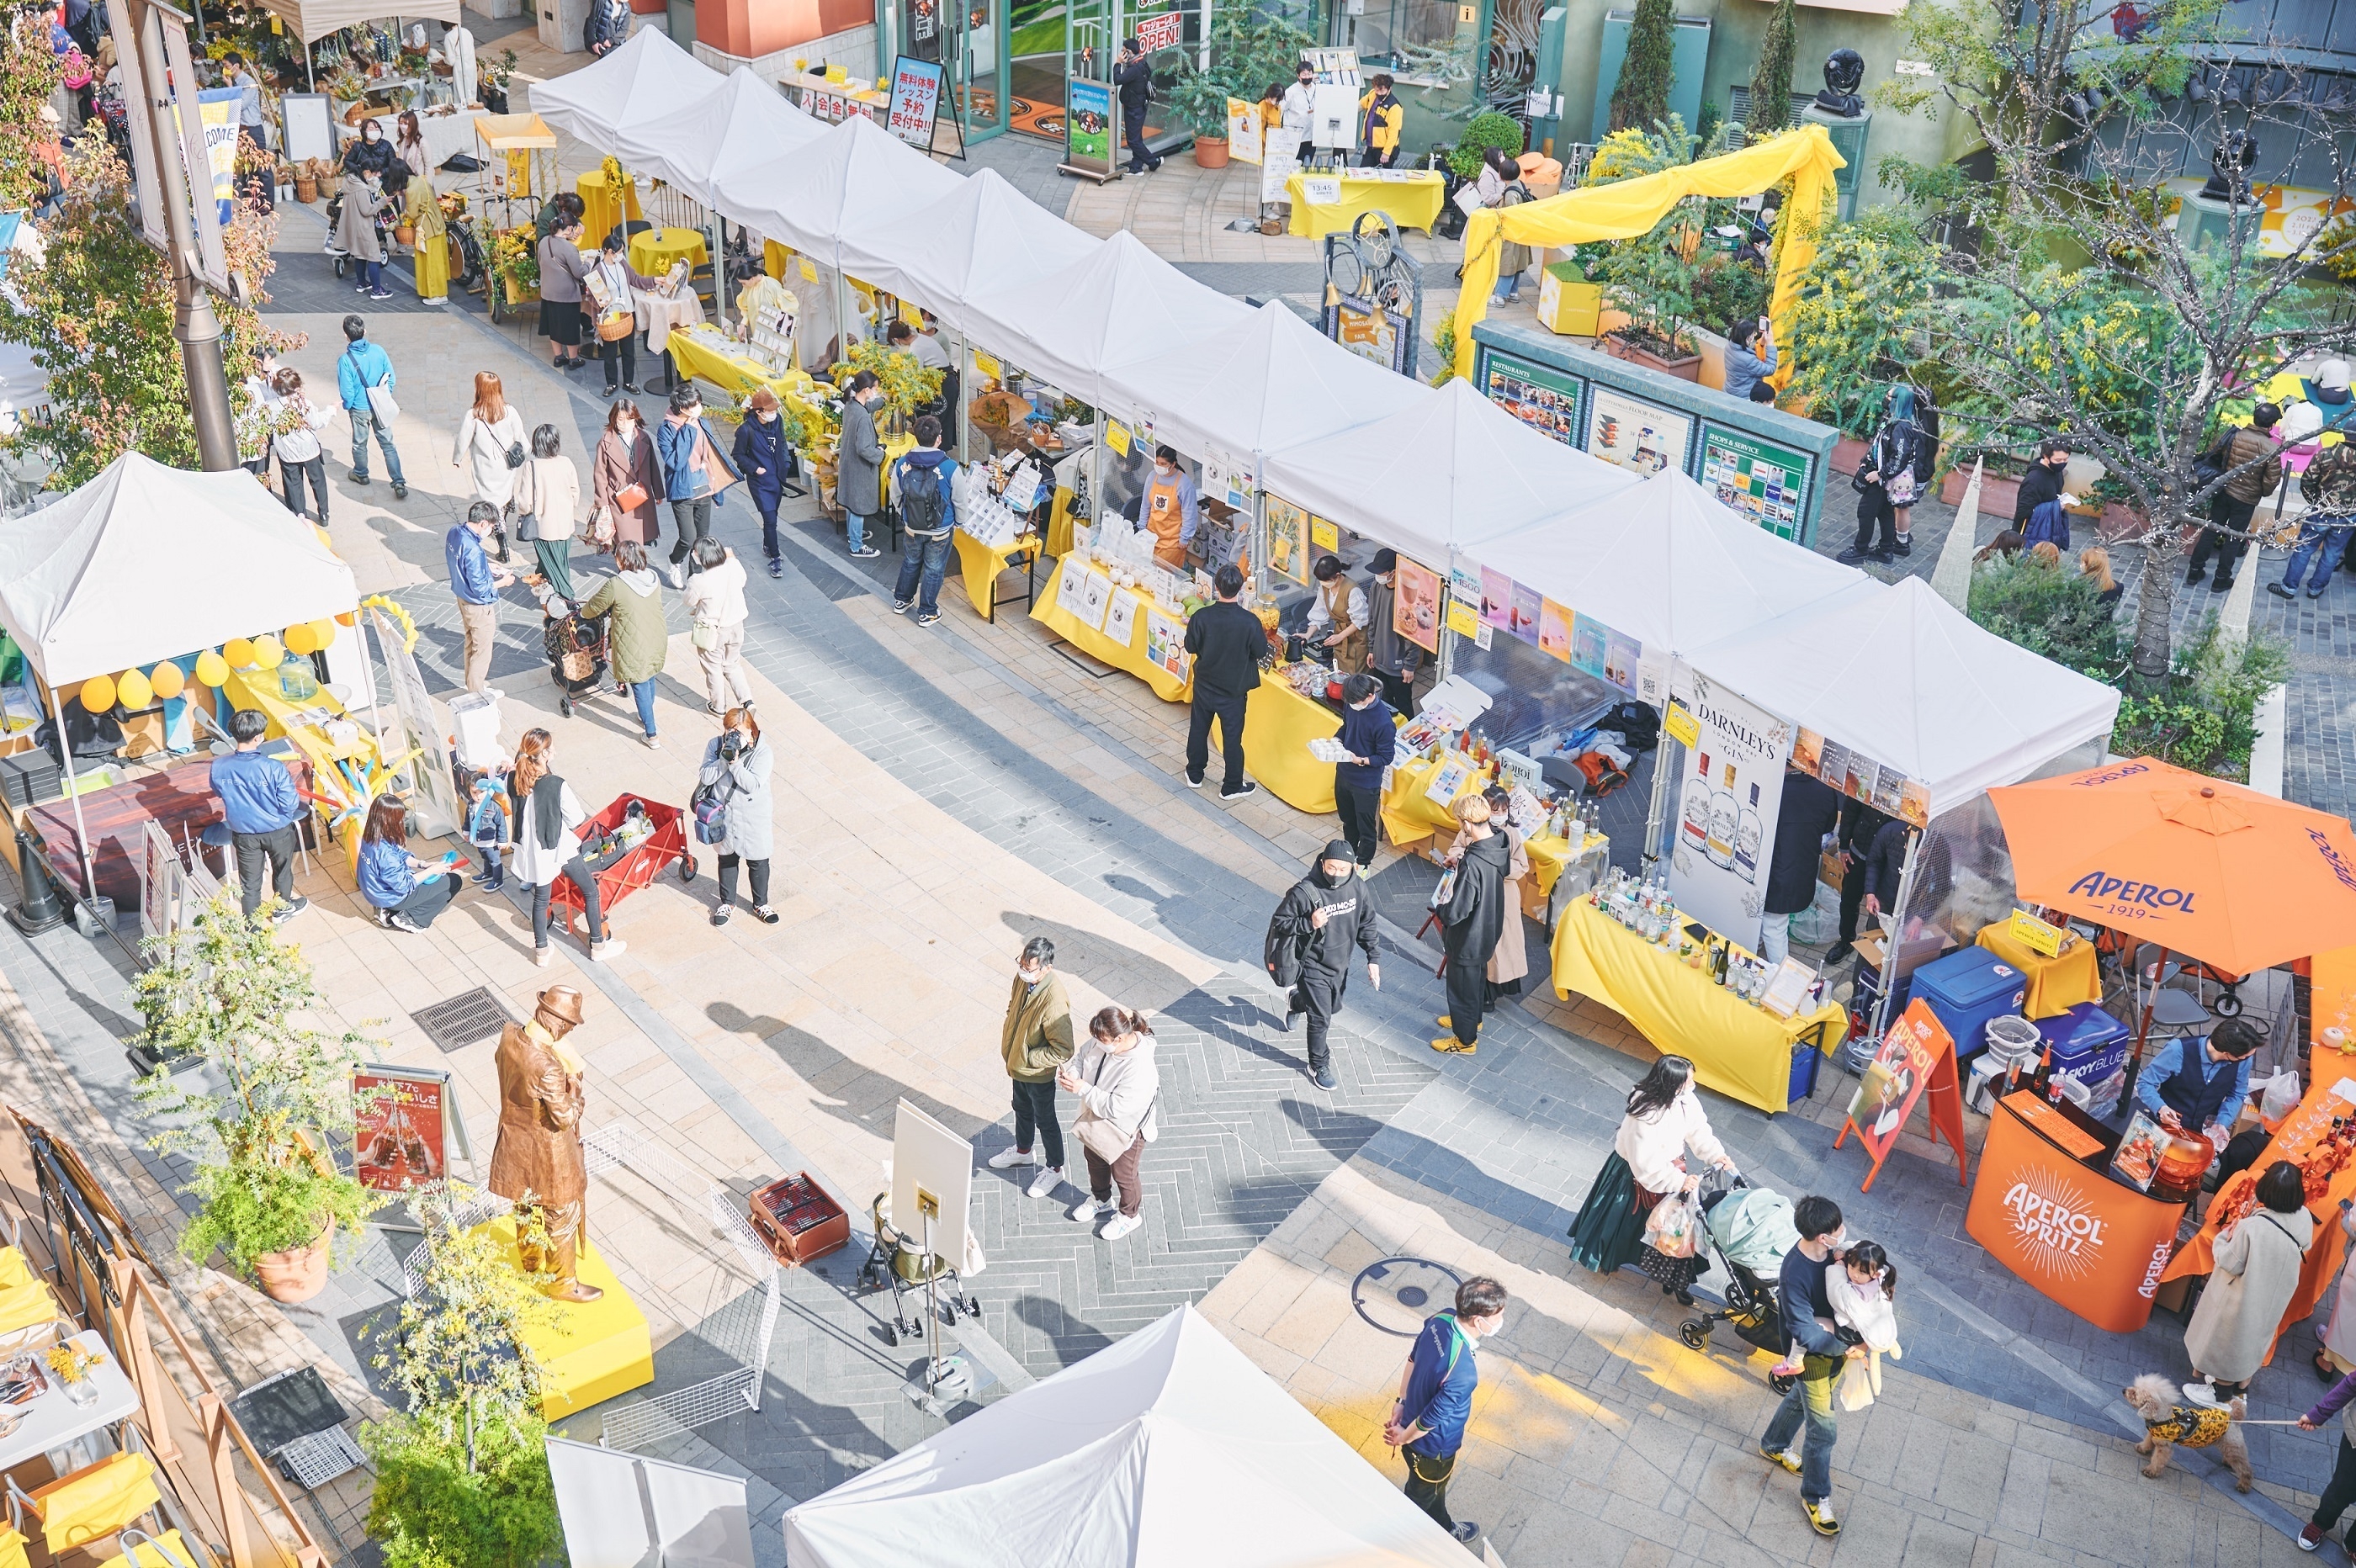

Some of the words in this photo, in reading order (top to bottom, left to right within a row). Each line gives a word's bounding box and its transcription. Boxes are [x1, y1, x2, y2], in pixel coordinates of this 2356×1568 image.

[1142, 15, 1176, 31] マッジョーレB1
[1138, 25, 1180, 55] OPEN!
[899, 72, 937, 91] 無料体験
[898, 85, 934, 101] レッスン
[902, 98, 925, 115] 予約
[890, 112, 931, 134] 受付中!!
[1492, 360, 1530, 379] RESTAURANTS
[1628, 405, 1649, 416] FLOOR
[1649, 412, 1664, 421] MAP
[1708, 432, 1729, 446] SHOPS
[1734, 442, 1760, 455] SERVICE
[1698, 703, 1776, 760] DARNLEY'S
[1712, 728, 1742, 749] LONDON
[1745, 749, 1758, 758] DRY
[1723, 745, 1744, 762] GIN
[2070, 764, 2150, 787] APEROL
[2067, 870, 2196, 914] APEROL
[2105, 903, 2146, 919] 1919
[2014, 929, 2035, 942] APEROL
[2035, 937, 2054, 950] SPRITZ
[1888, 1019, 1934, 1086] APEROL
[2003, 1181, 2104, 1246] APEROL
[2137, 1240, 2172, 1299] APEROL
